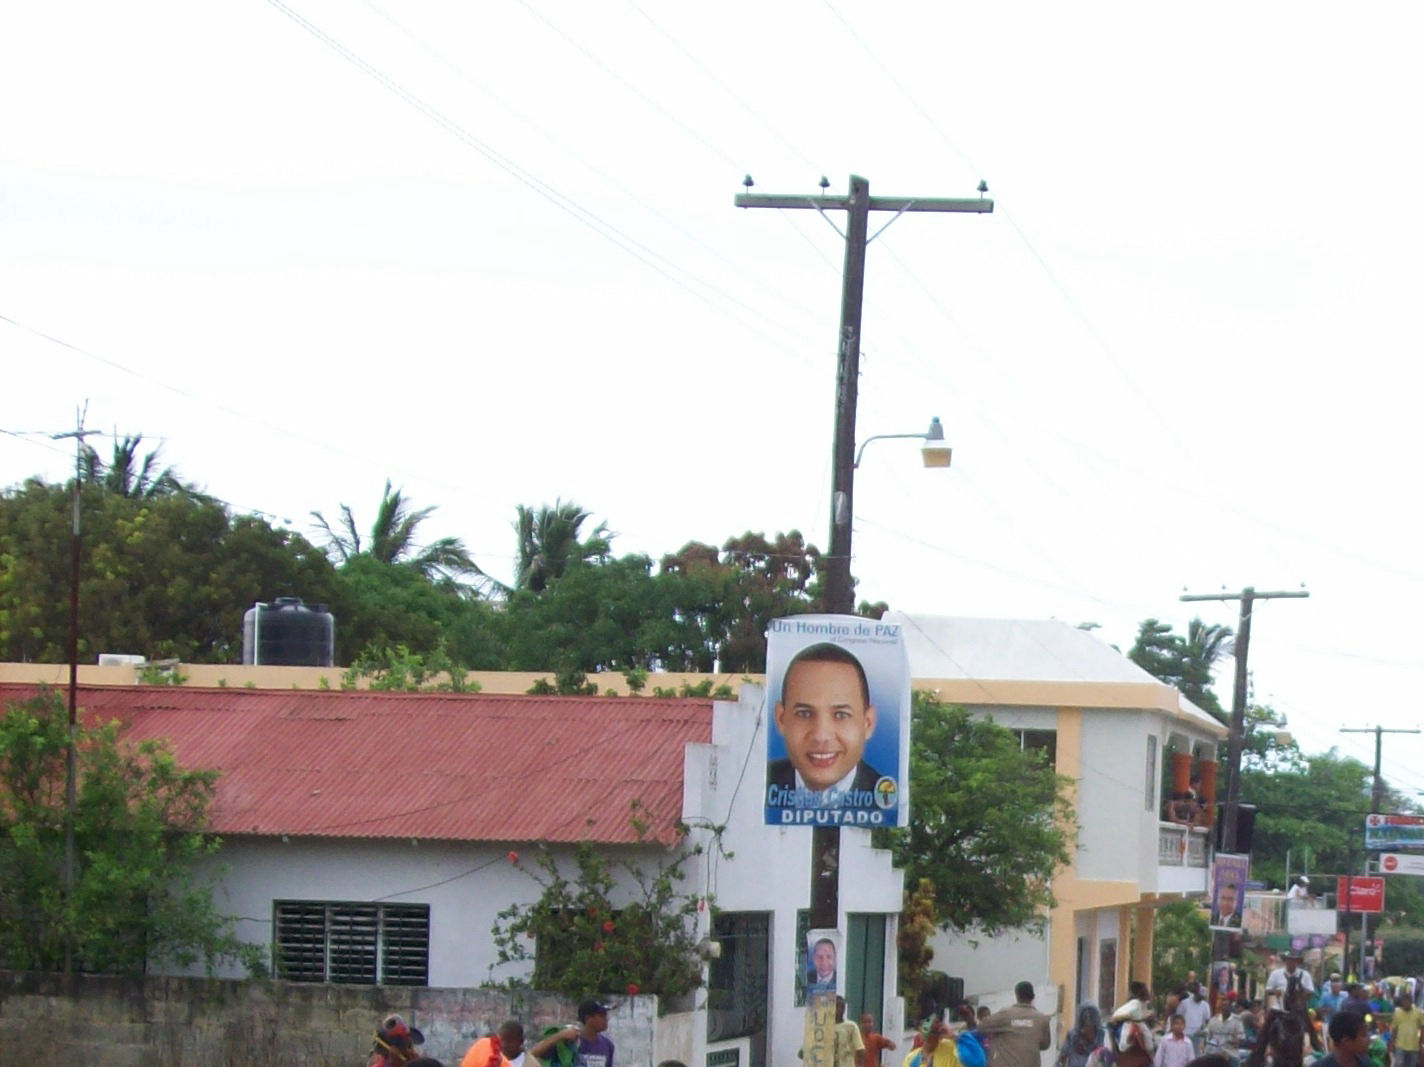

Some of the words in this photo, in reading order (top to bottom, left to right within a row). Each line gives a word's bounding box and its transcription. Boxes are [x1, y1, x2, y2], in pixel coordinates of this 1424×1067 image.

[772, 620, 791, 633] Un
[796, 621, 849, 636] Hombre
[854, 623, 870, 636] de
[875, 624, 900, 638] PAZ
[781, 809, 884, 824] DIPUTADO
